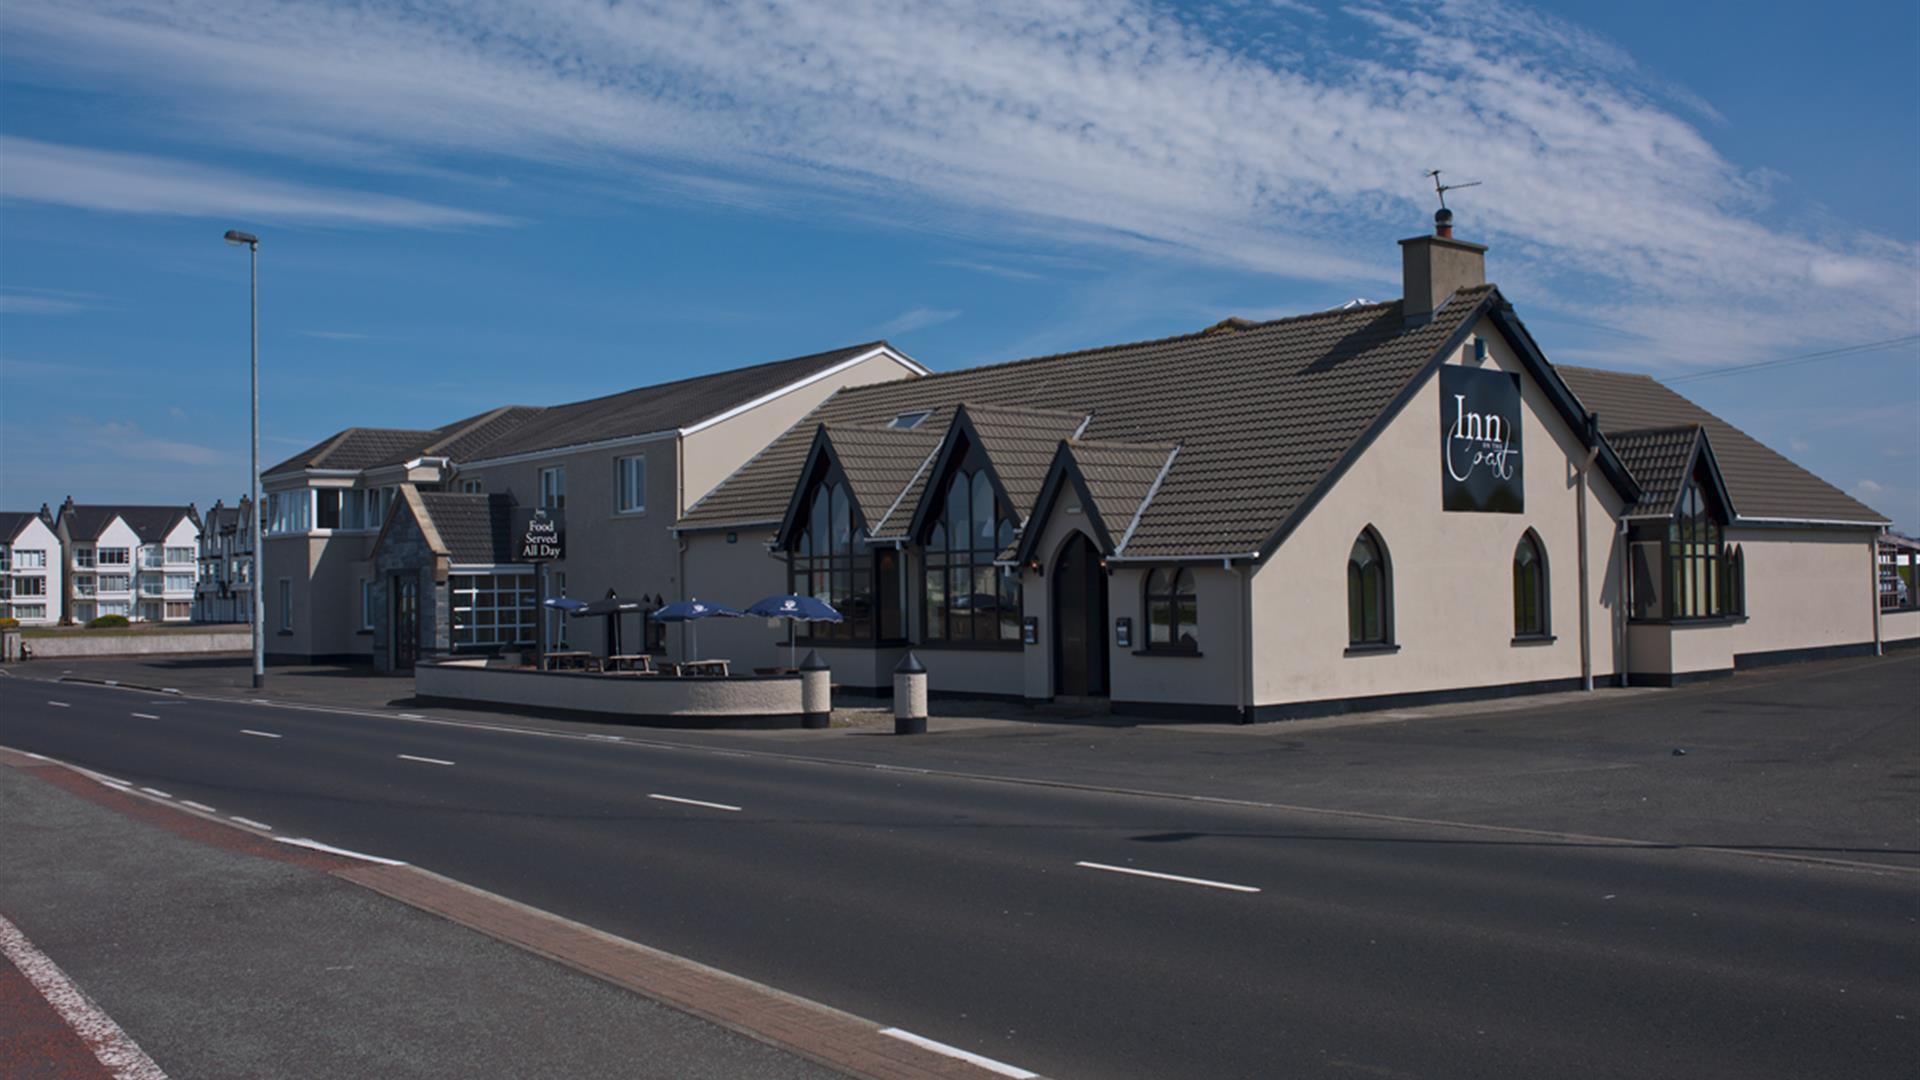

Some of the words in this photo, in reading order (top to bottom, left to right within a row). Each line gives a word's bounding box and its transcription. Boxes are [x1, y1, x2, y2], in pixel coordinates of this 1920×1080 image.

[1454, 394, 1502, 442] Inn
[1447, 415, 1518, 481] Coast
[529, 520, 554, 532] Food
[525, 532, 558, 544] Served
[522, 544, 539, 556] All
[540, 544, 561, 559] Day
